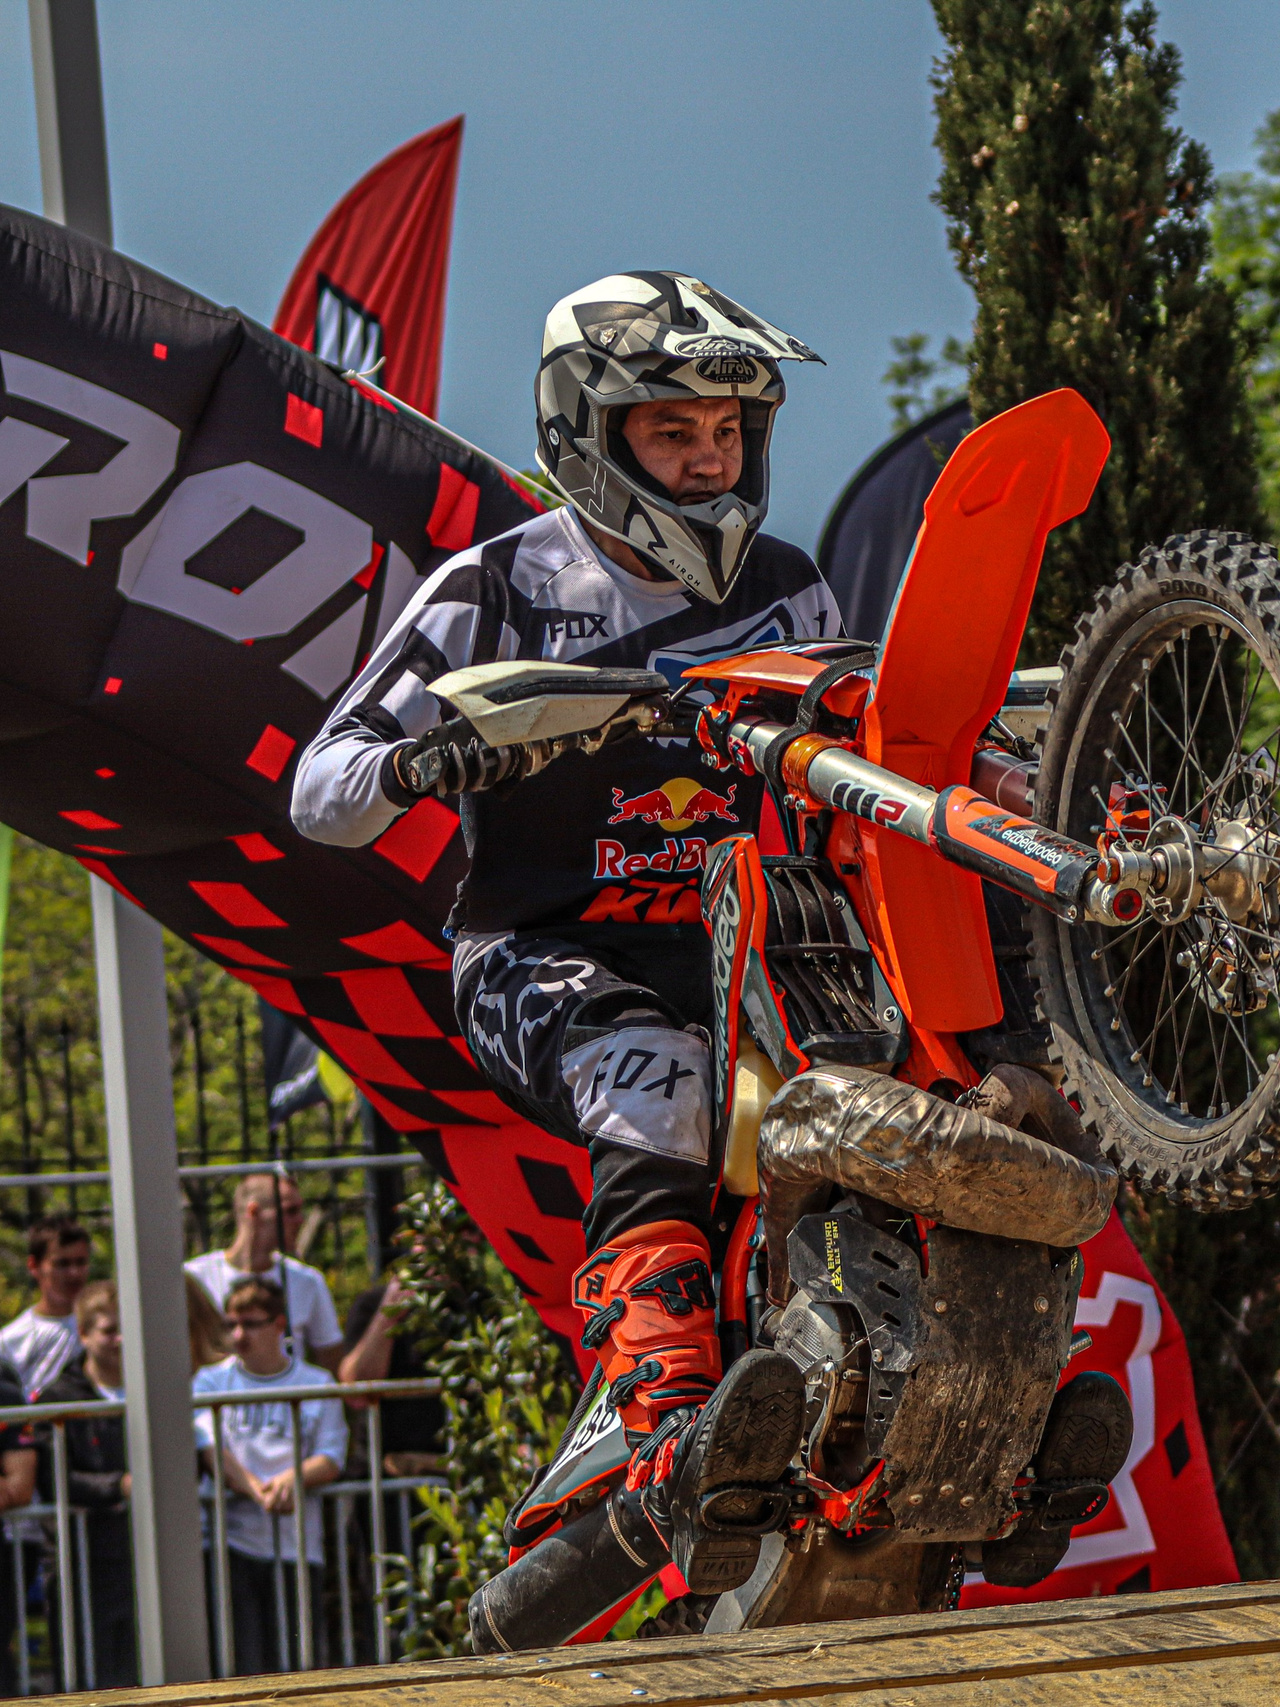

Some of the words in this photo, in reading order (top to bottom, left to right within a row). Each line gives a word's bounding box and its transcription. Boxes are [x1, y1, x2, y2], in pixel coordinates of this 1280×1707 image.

[703, 357, 754, 376] Airoh
[668, 558, 701, 587] AIROH
[547, 613, 608, 643] FOX
[1001, 829, 1063, 865] erzbergrodeo
[591, 1048, 696, 1105] FOX
